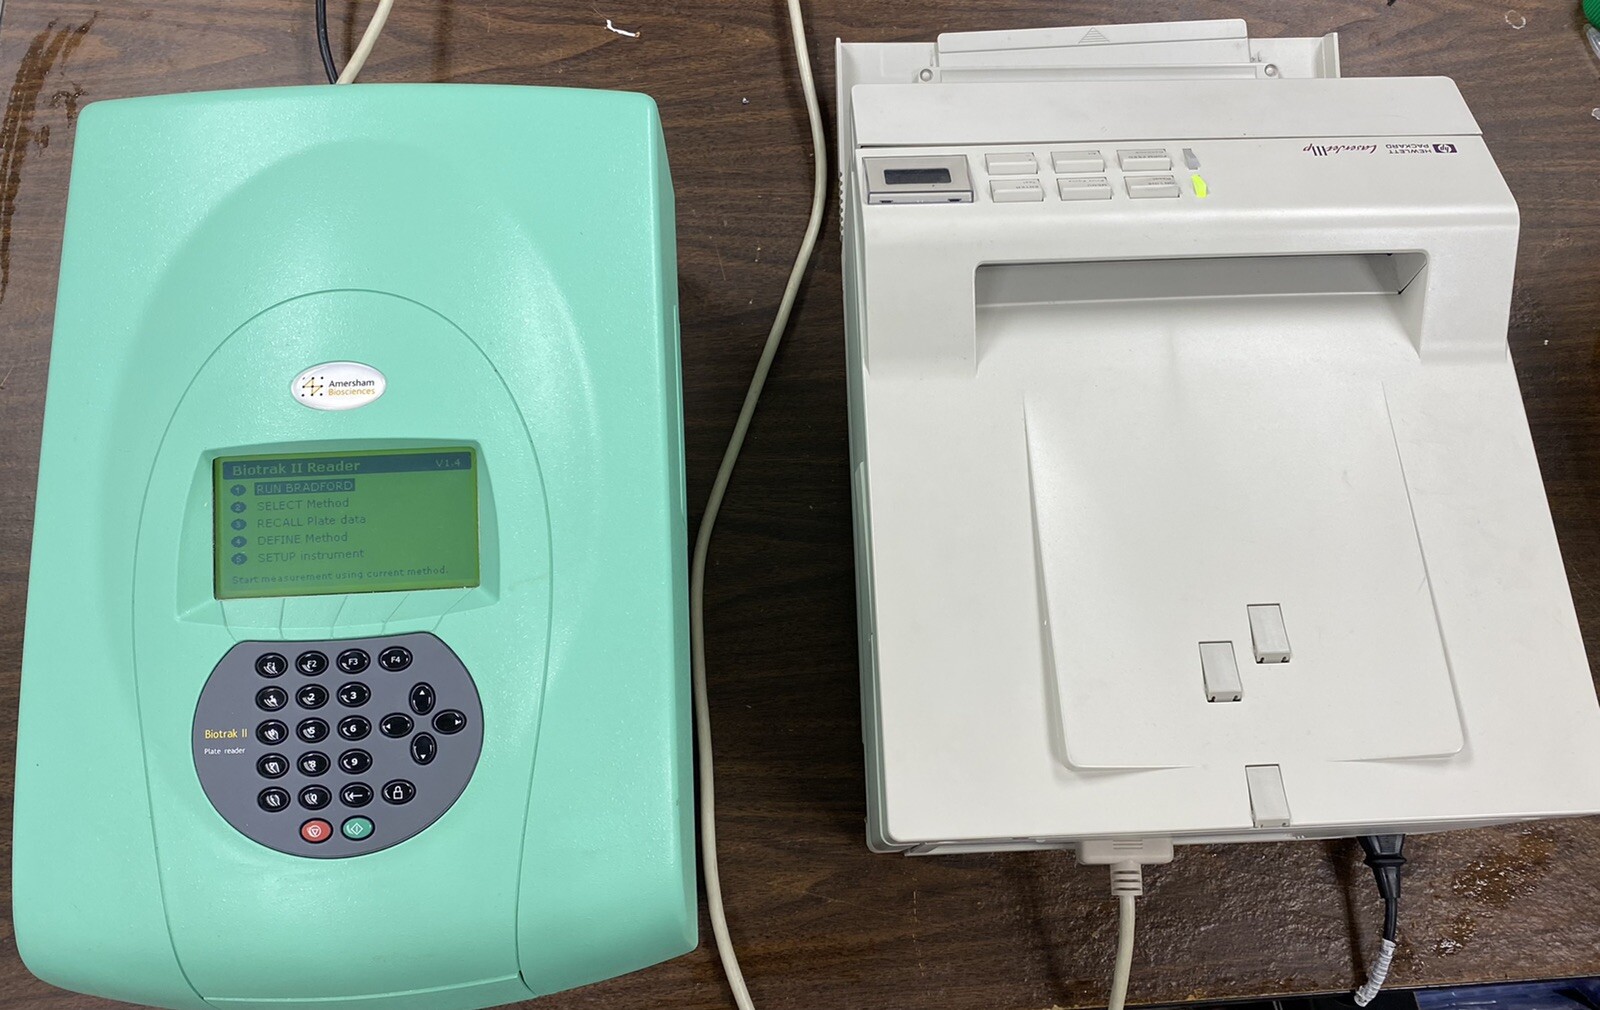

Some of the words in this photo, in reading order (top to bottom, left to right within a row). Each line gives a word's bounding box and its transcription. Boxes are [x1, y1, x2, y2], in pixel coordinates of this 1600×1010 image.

[328, 379, 375, 387] Amersham
[232, 463, 287, 476] Biotrak
[291, 462, 302, 474] II
[307, 460, 360, 473] Reader
[256, 484, 281, 494] RUN
[286, 482, 353, 493] BRADFORD
[257, 500, 302, 512] SELECT
[306, 498, 350, 509] Method
[257, 518, 304, 528] RECALL
[308, 516, 336, 526] Plate
[340, 515, 366, 524] data
[257, 535, 300, 546] DEFINE
[305, 532, 348, 543] Method
[258, 552, 296, 562] SETUP
[300, 550, 365, 560] instrument
[232, 576, 258, 584] Start
[262, 572, 332, 583] measurement
[336, 571, 363, 579] using
[366, 568, 404, 578] current
[407, 566, 448, 576] method.
[350, 692, 357, 700] 3
[350, 724, 357, 732] 6
[204, 729, 238, 740] Biotrak
[351, 758, 358, 766] 9
